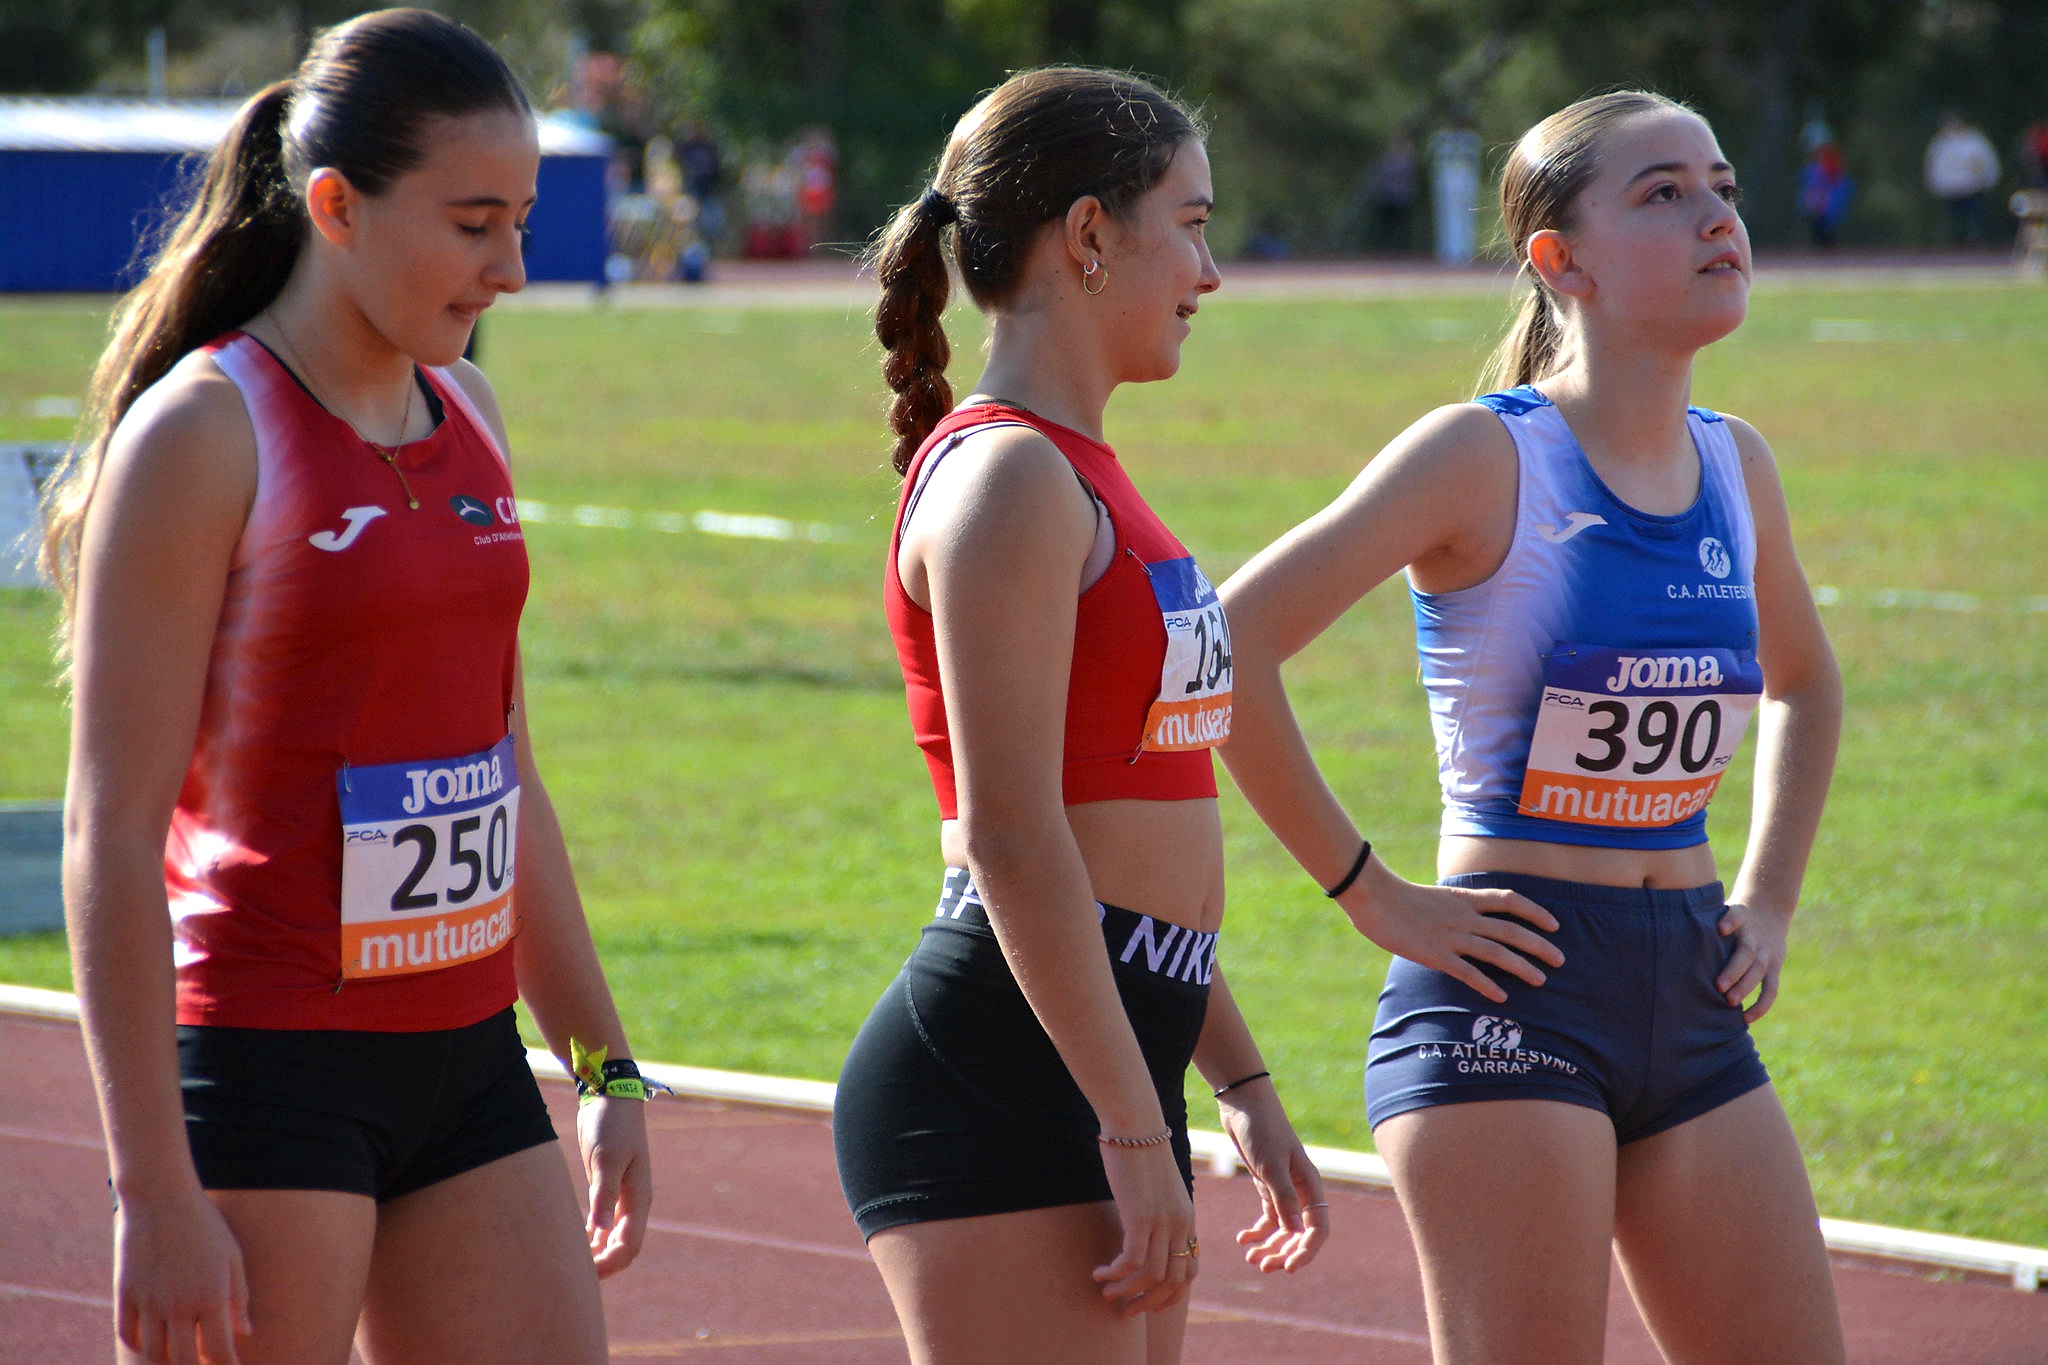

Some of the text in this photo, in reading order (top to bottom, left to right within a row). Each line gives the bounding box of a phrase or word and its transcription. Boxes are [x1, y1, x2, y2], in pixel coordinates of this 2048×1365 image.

[1667, 584, 1695, 599] C.A.
[1165, 616, 1192, 629] FCA
[1545, 692, 1585, 706] FCA
[1575, 699, 1722, 775] 390
[346, 829, 388, 843] FCA
[390, 804, 508, 912] 250
[361, 894, 512, 971] mutuacat
[1419, 1044, 1447, 1060] C.A.
[1457, 1060, 1533, 1074] GARRAF
